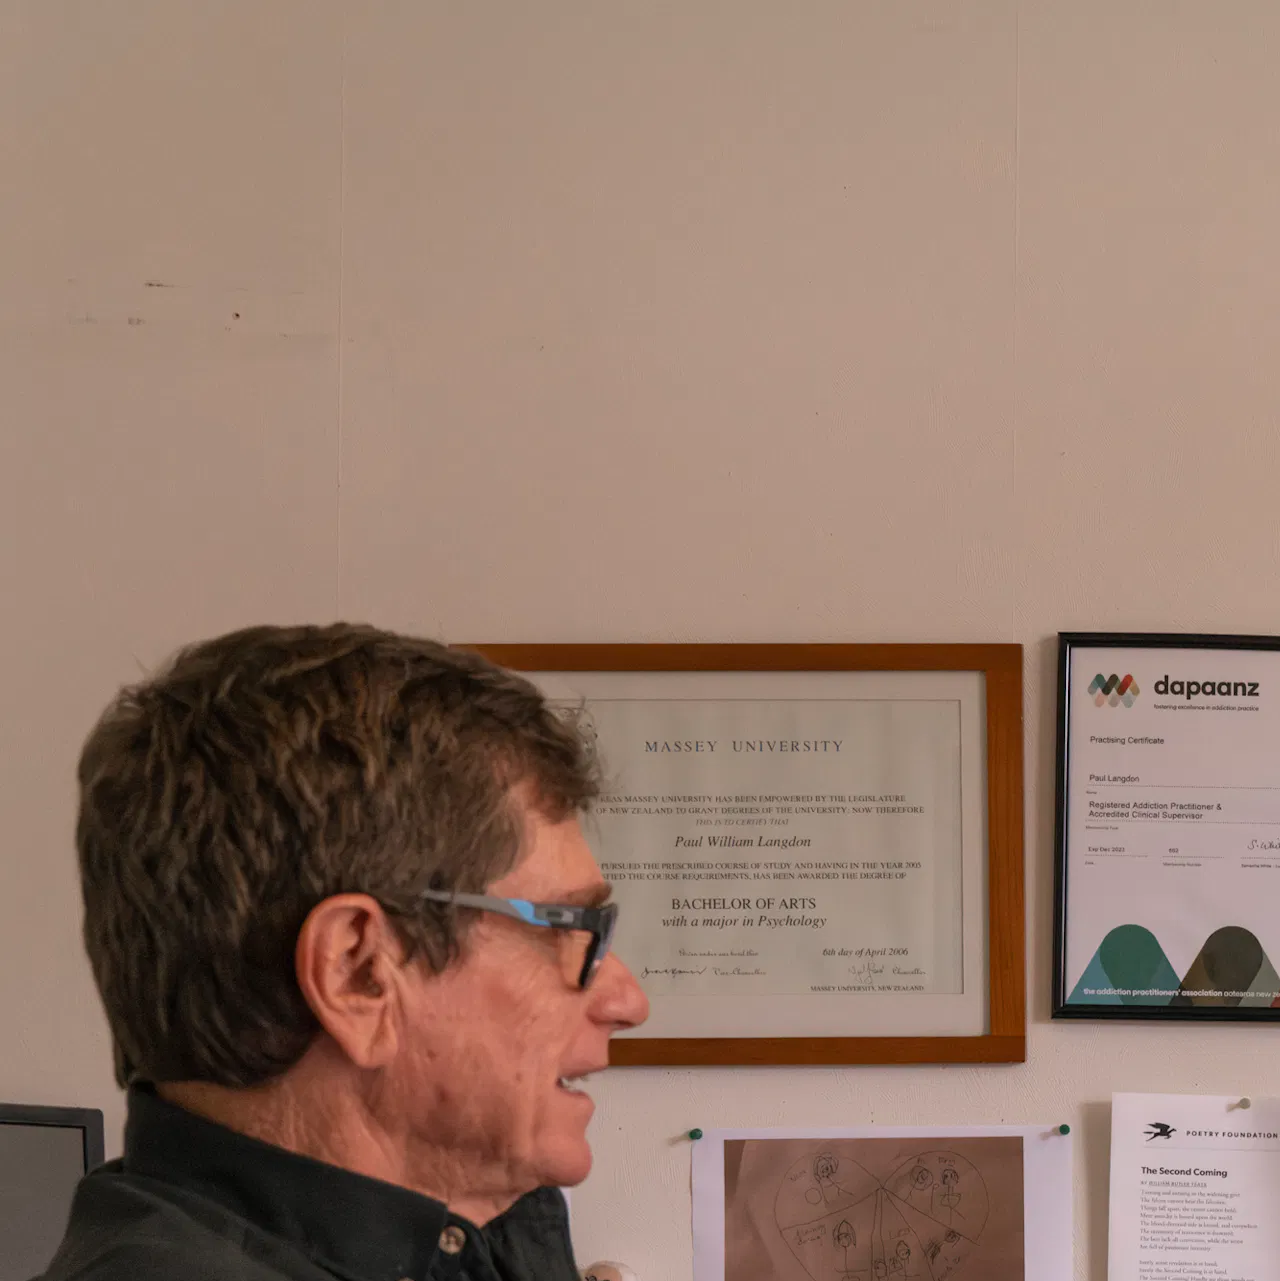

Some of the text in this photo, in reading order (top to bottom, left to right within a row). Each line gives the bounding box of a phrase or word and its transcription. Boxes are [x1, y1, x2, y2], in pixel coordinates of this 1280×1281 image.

[1154, 675, 1259, 700] dapaanz
[645, 740, 843, 752] MASSEY UNIVERSITY
[1090, 736, 1165, 746] Practising Certificate
[1089, 774, 1140, 784] Paul Langdon
[624, 795, 659, 803] MASSEY
[609, 807, 630, 815] NEW
[1089, 801, 1222, 811] Registered Addiction Practitioner &
[1088, 811, 1203, 821] Accredited Clinical Supervisor
[675, 836, 811, 849] Paul William Langdon
[750, 862, 762, 870] OF
[763, 862, 791, 870] STUDY
[841, 872, 858, 880] THE
[859, 872, 893, 880] DEGREE
[895, 872, 907, 880] OF
[671, 898, 817, 910] BACHELOR OF ARTS
[662, 915, 827, 930] with a major in Psychology
[822, 947, 909, 958] 6th day of April 2006
[1096, 988, 1131, 996] addiction
[1181, 989, 1223, 997] association
[1222, 1131, 1279, 1139] FOUNDATION
[1141, 1166, 1228, 1178] The Second Coming
